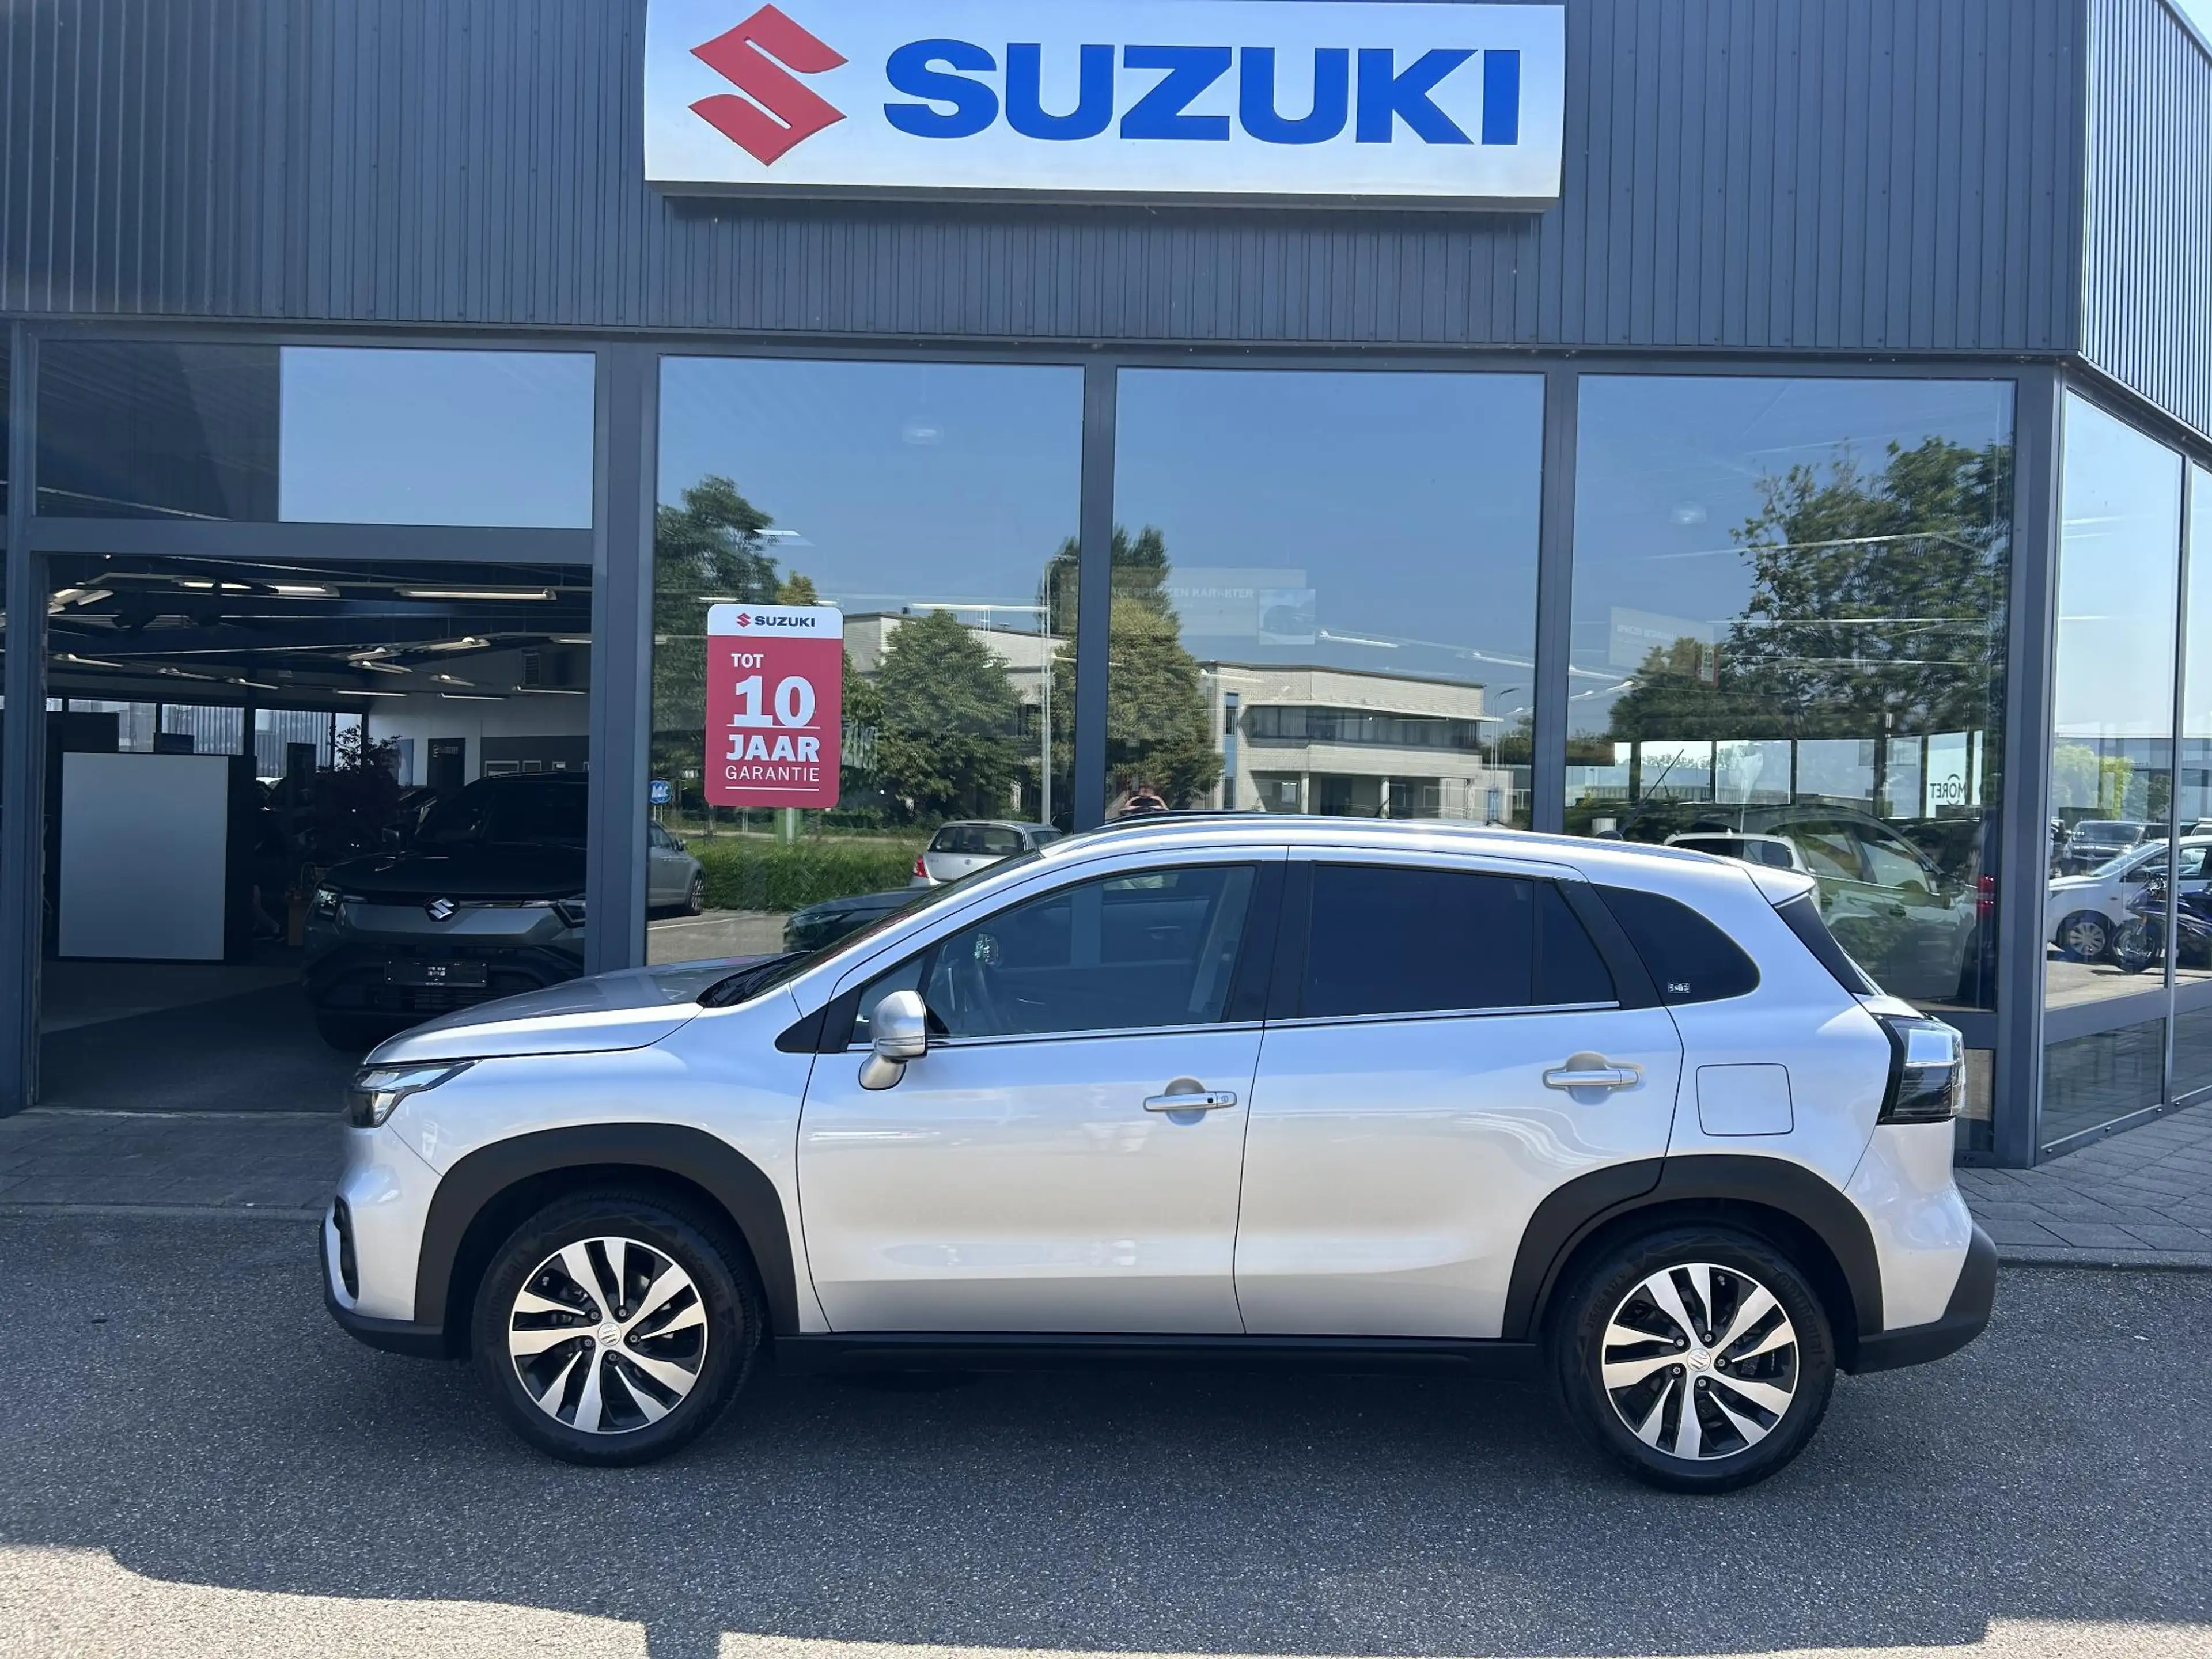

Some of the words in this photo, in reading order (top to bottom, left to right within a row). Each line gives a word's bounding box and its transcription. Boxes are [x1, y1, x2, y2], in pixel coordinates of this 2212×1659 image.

[883, 38, 1520, 145] SUZUKI
[755, 615, 815, 627] SUZUKI
[731, 653, 764, 668] TOT
[734, 675, 816, 727] 10
[726, 734, 820, 762] JAAR
[725, 766, 820, 782] GARANTIE
